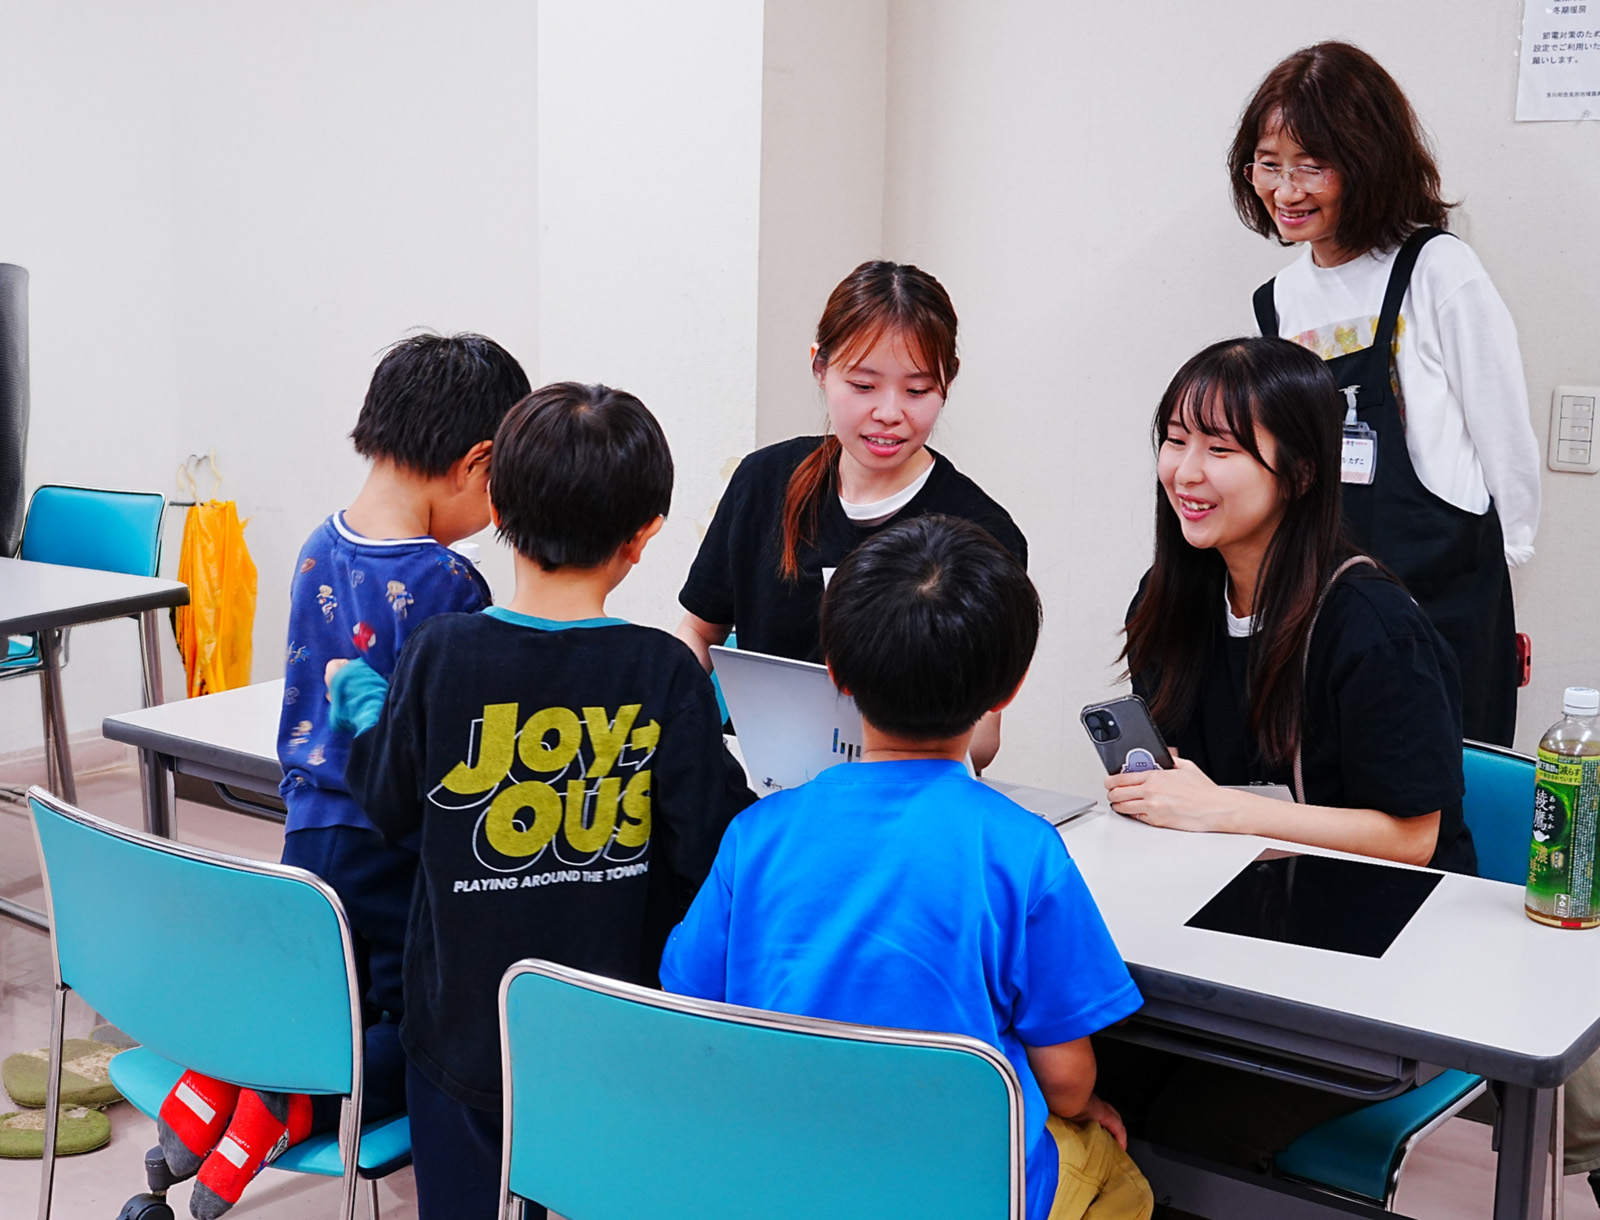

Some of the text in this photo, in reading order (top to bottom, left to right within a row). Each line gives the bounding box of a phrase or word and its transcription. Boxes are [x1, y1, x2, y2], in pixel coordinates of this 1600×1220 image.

[485, 769, 651, 858] OUS
[453, 877, 519, 893] PLAYING
[520, 870, 581, 888] AROUND
[582, 870, 605, 882] THE
